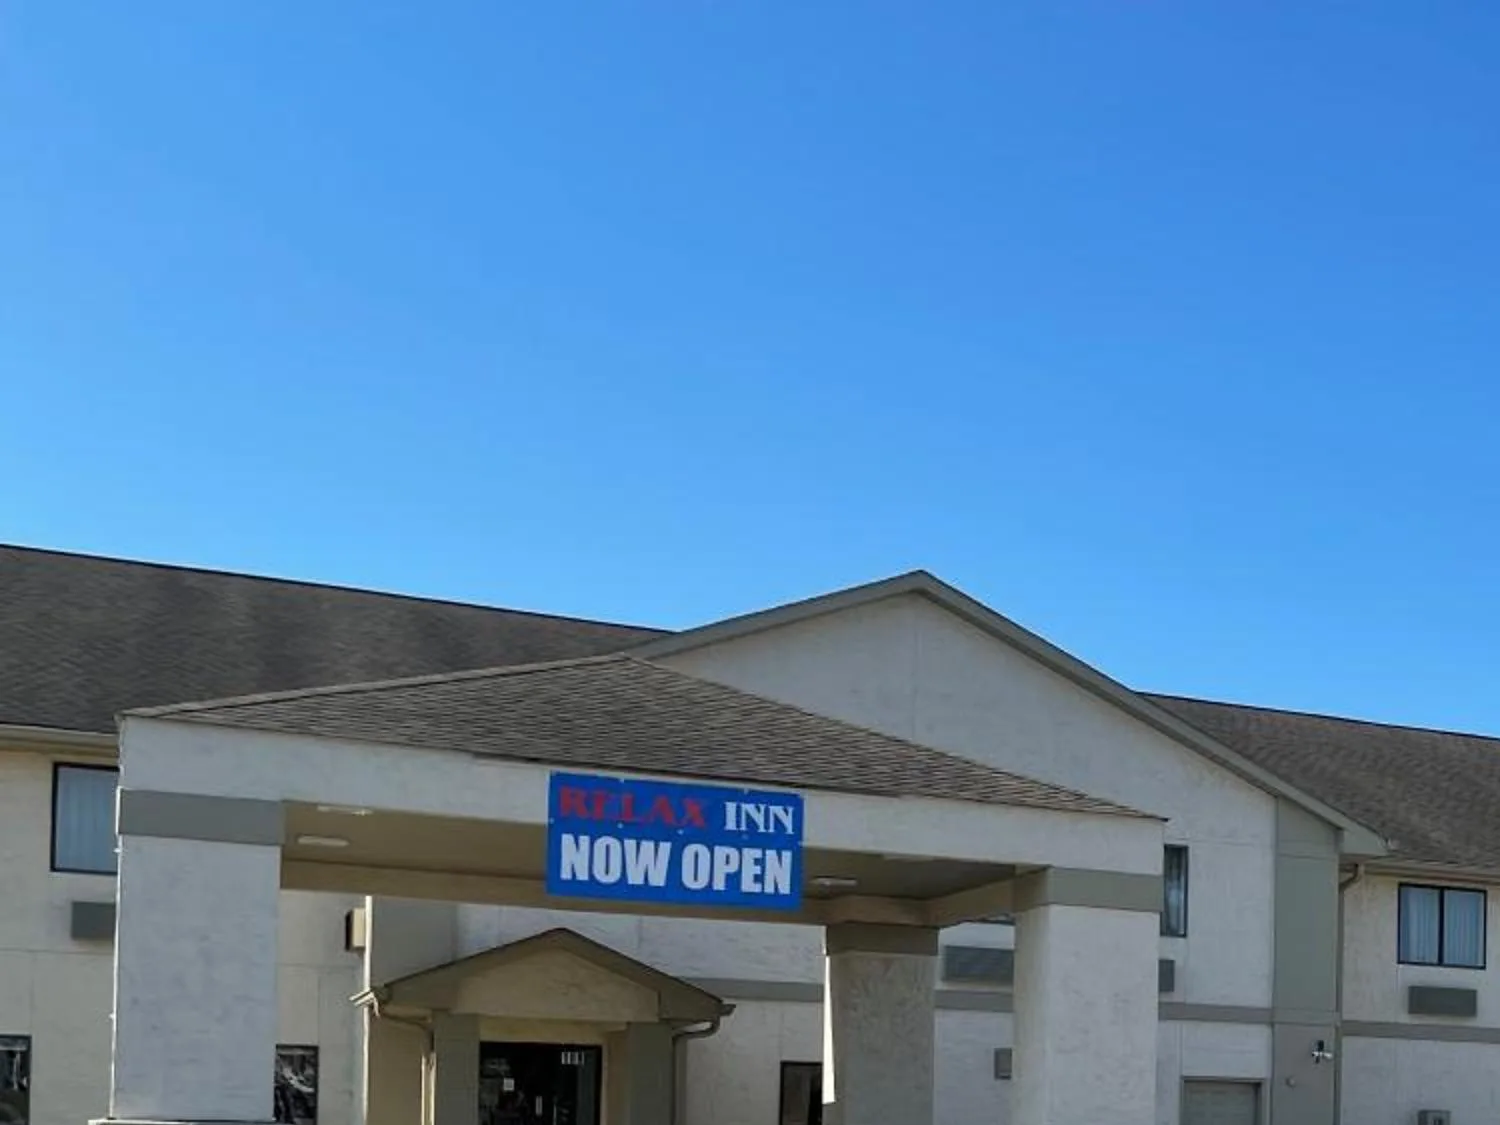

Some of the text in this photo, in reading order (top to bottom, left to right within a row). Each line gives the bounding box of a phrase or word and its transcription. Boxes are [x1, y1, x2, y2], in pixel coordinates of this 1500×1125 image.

[559, 785, 795, 835] RELAX INN
[560, 833, 793, 895] NOW OPEN
